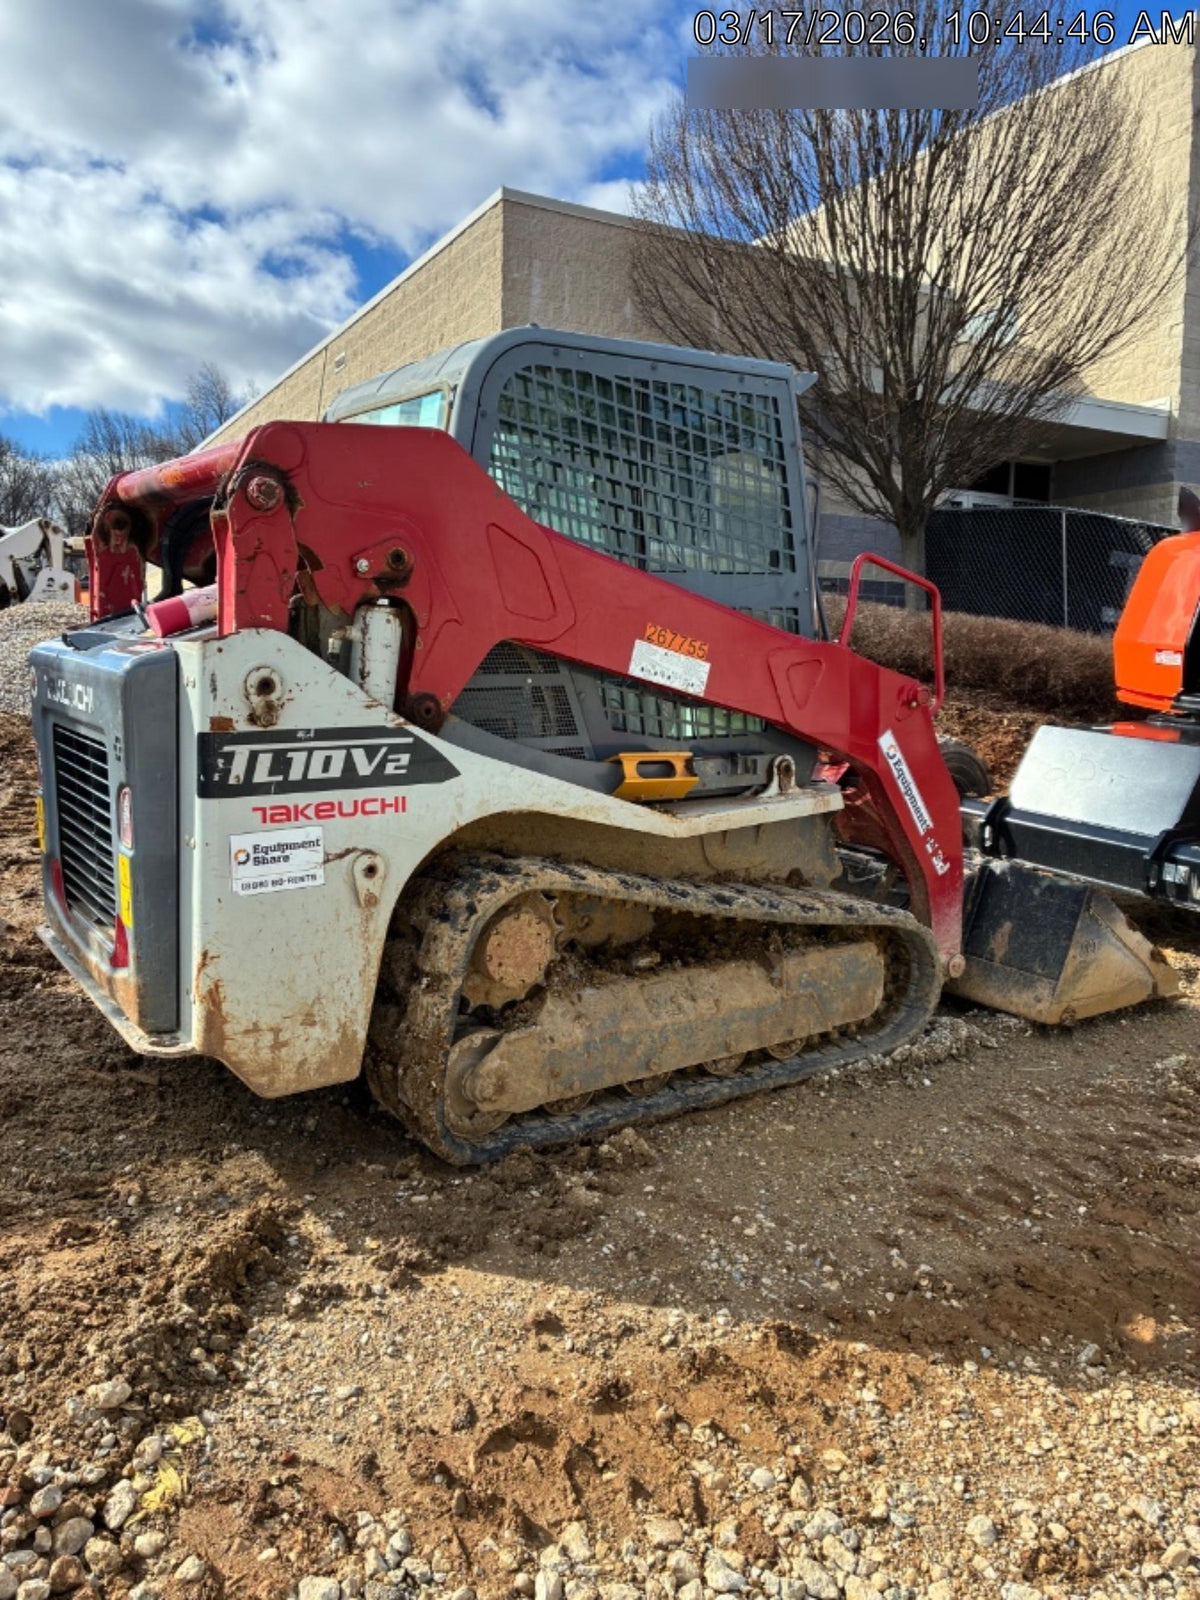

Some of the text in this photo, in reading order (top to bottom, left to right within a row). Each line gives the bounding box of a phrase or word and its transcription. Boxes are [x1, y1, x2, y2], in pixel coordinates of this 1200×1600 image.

[645, 624, 708, 659] 267755
[219, 737, 414, 785] TL10V2
[252, 796, 407, 824] TAKEUCHI
[892, 758, 929, 831] Equipment
[253, 838, 321, 855] Equipment
[253, 854, 290, 866] Share
